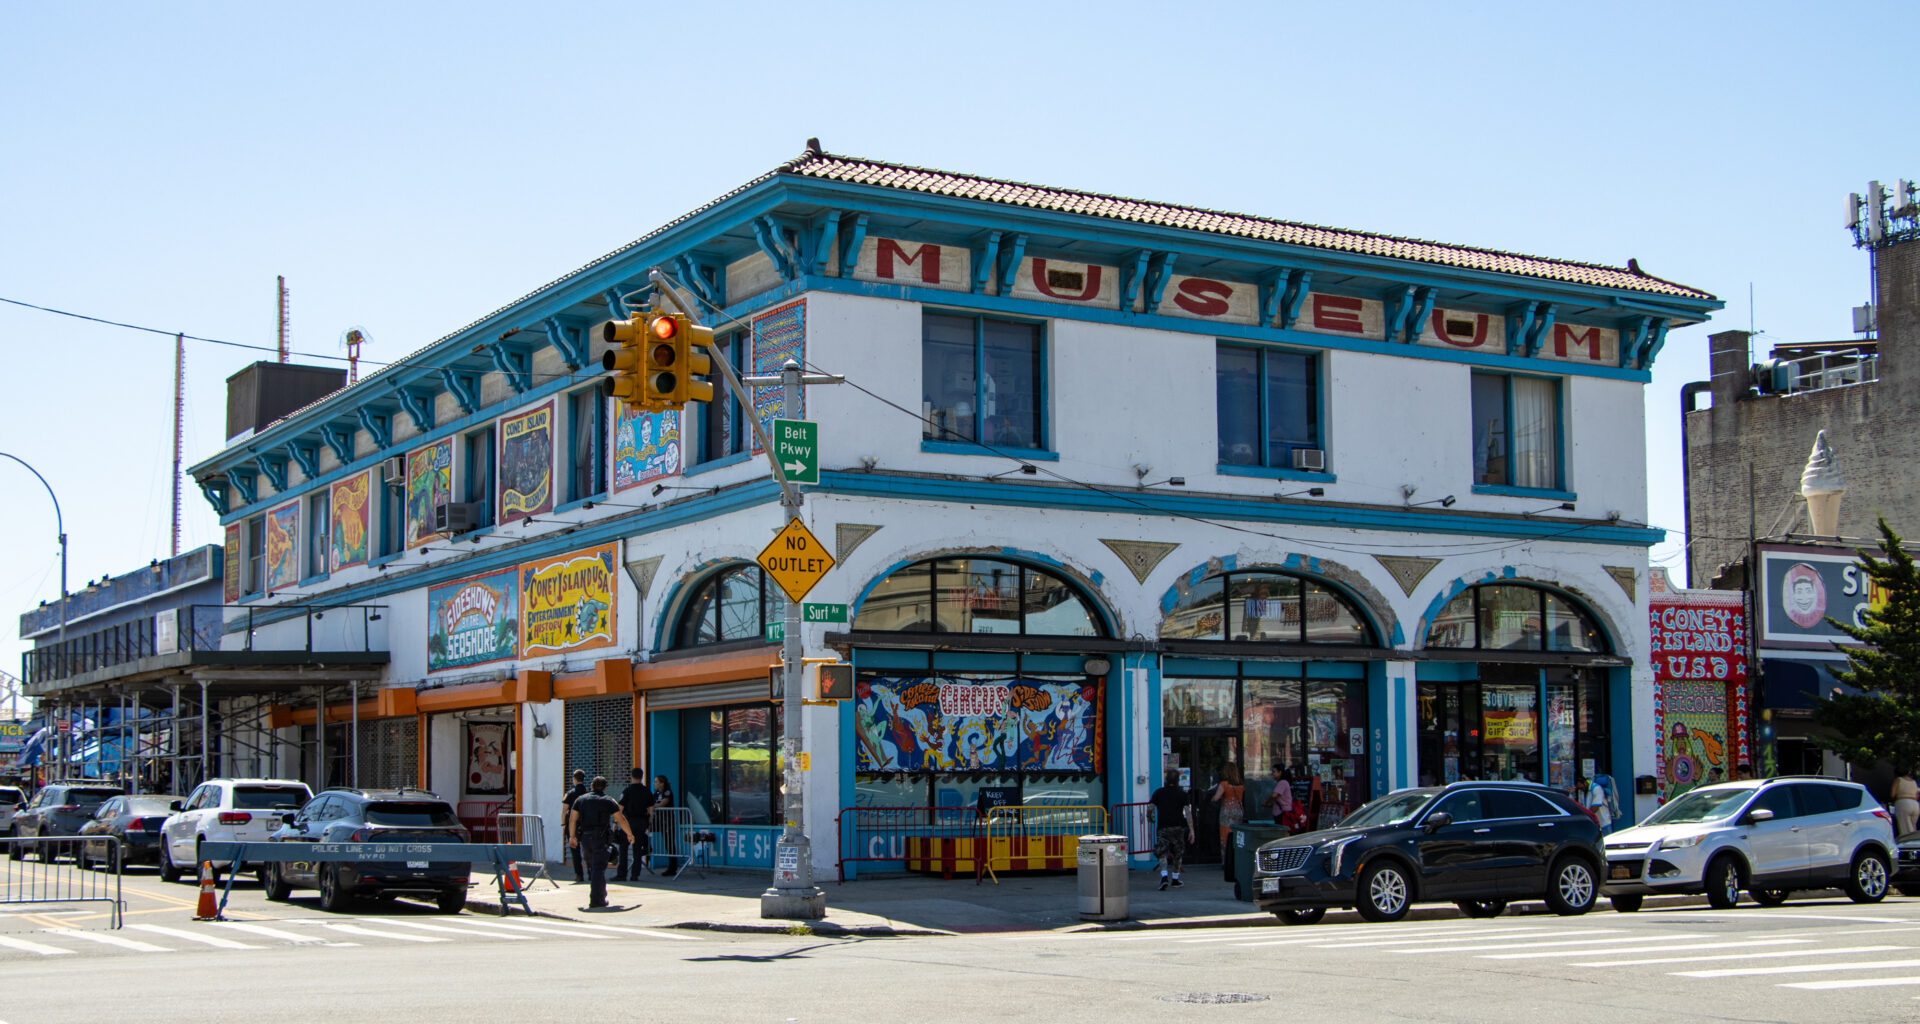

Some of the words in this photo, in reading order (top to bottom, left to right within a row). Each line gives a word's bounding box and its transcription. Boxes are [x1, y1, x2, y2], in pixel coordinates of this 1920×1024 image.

[875, 237, 1602, 361] MUSEUM
[506, 419, 523, 437] CONEY
[526, 412, 547, 430] ISLAND
[784, 426, 807, 440] Belt
[780, 442, 811, 458] Pkwy
[786, 536, 807, 551] NO
[768, 557, 825, 573] OUTLET
[530, 576, 556, 609] CONEY
[556, 567, 593, 602] ISLAND
[592, 565, 609, 593] USA
[446, 586, 496, 633] SIDESHOWS
[527, 604, 576, 629] ENTERTAINMENT
[809, 604, 829, 621] Surf
[1661, 606, 1731, 631] CONEY
[533, 619, 562, 638] HISTORY
[447, 625, 496, 660] SEASHORE
[1662, 632, 1732, 652] ISLAND
[1665, 682, 1688, 693] ALL
[1693, 682, 1715, 694] ARE
[940, 684, 1009, 716] CIRCUS
[1417, 696, 1432, 720] TS
[1487, 727, 1505, 737] GIFT
[1507, 727, 1531, 737] SHOP
[1163, 739, 1170, 749] A
[985, 790, 1004, 799] KEEP
[311, 844, 340, 853] POLICE
[345, 844, 363, 853] LINE
[375, 844, 385, 853] DO
[388, 844, 403, 853] NOT
[406, 844, 432, 853] CROSS
